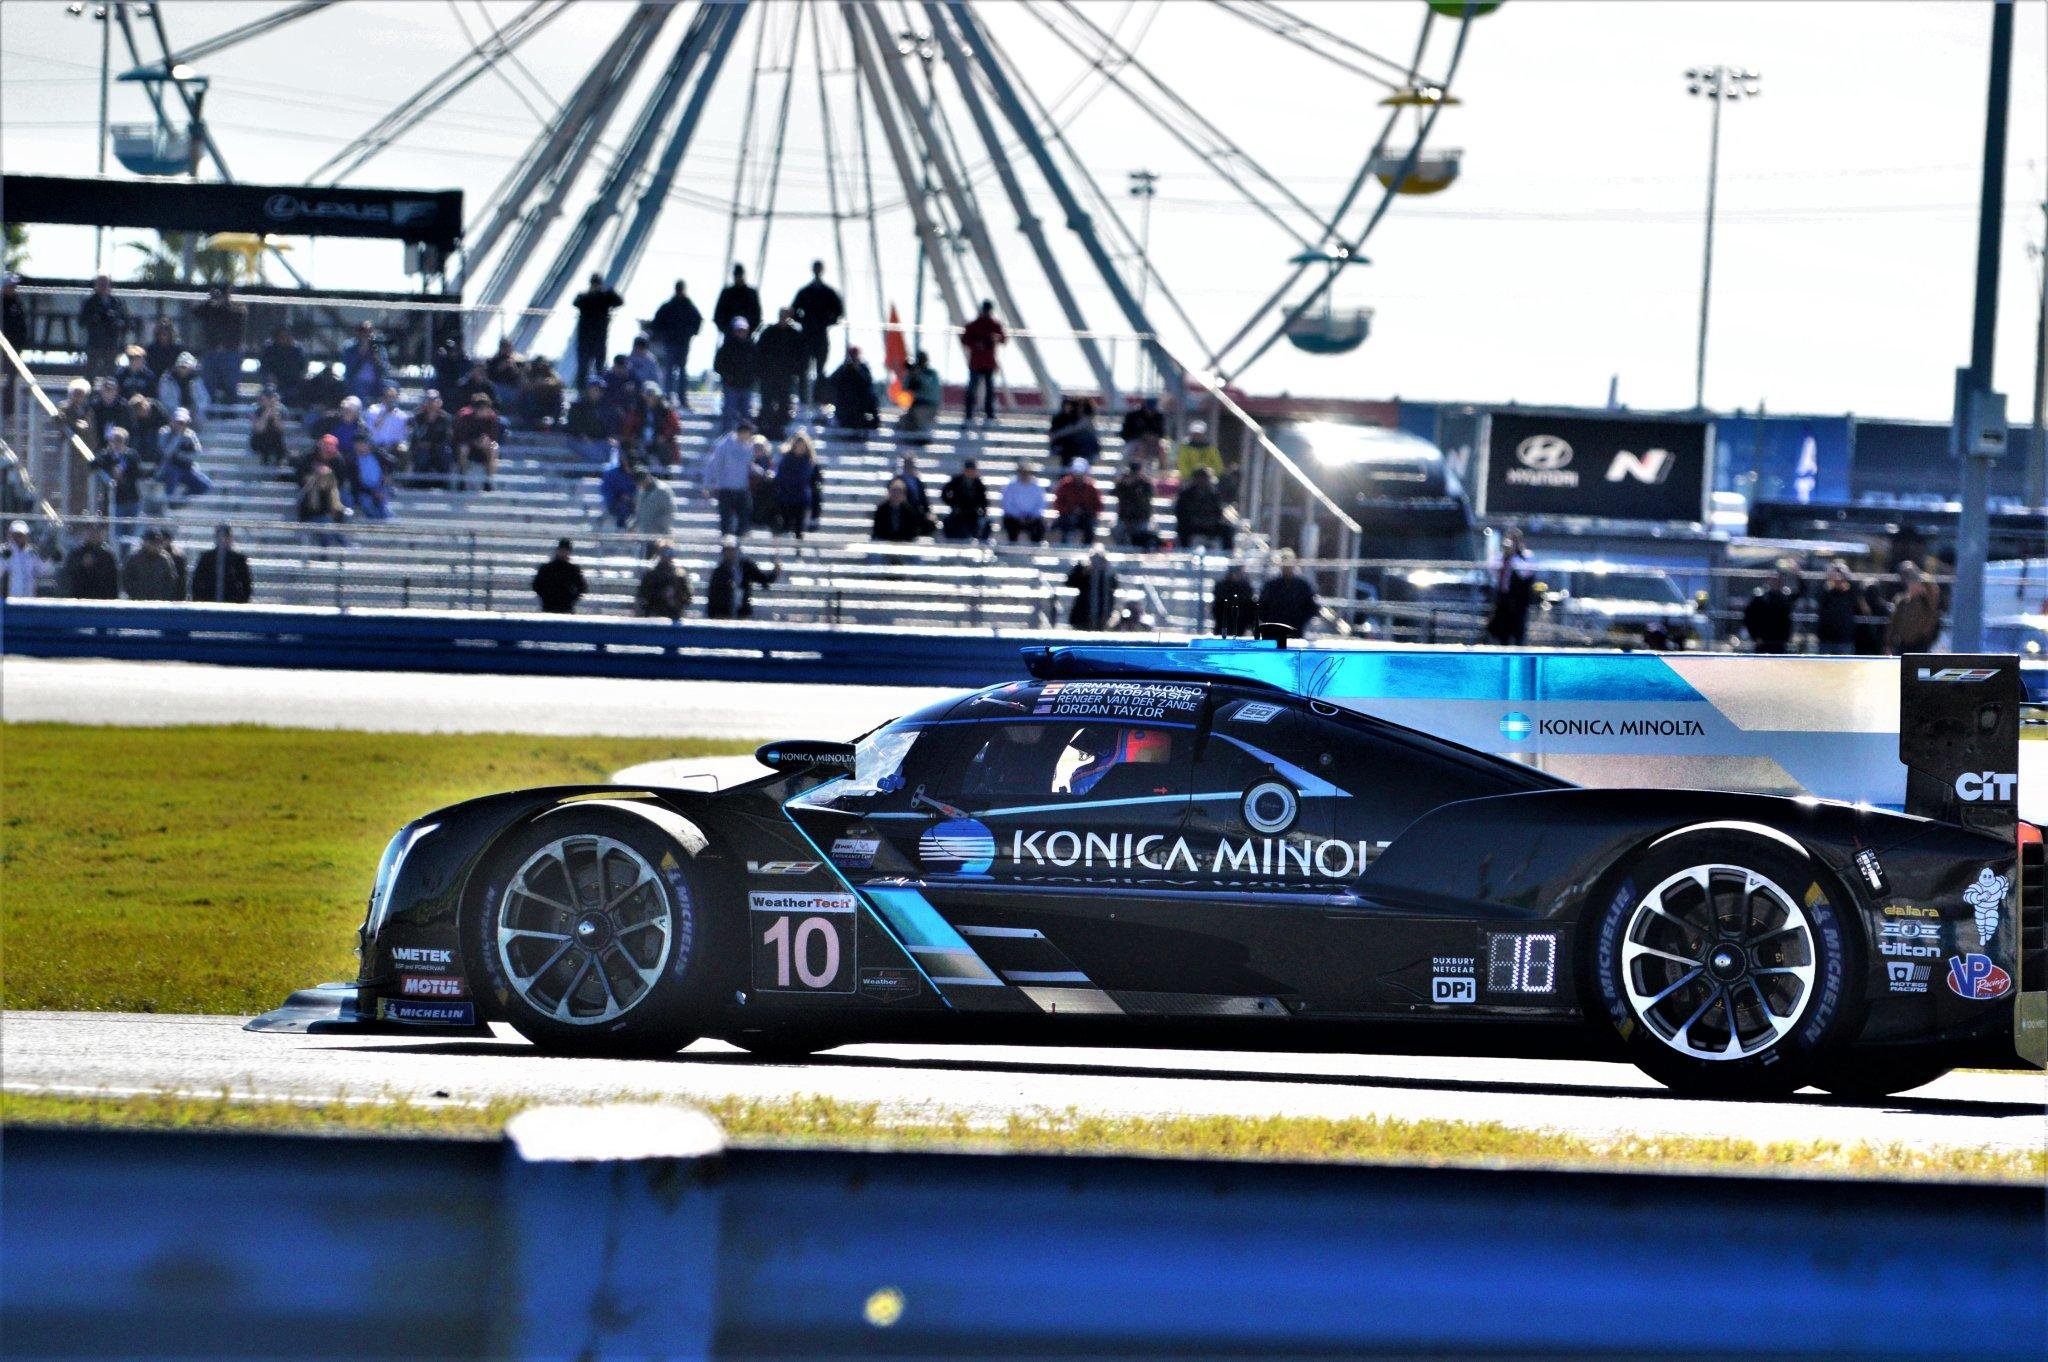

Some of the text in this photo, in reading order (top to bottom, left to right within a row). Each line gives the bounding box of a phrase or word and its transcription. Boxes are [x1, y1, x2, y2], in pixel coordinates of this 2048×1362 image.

[301, 200, 390, 220] LEXUS
[1065, 682, 1202, 696] FERNANDO ALONSO
[1113, 689, 1191, 701] KOBAYASHI
[1057, 695, 1197, 711] RENGER VAN DER ZANDE
[1053, 704, 1164, 718] JORDAN TAYLOR
[1539, 719, 1705, 736] KONICA MINOLTA
[781, 753, 857, 763] KONICA MINOLTA
[1013, 829, 1198, 872] KONICA
[752, 896, 852, 909] WeatherTech
[1884, 905, 1939, 918] dallara
[1599, 886, 1632, 998] MICHELIN
[1878, 942, 1941, 957] tilton
[764, 916, 840, 988] 10
[1433, 957, 1475, 965] DUXBURY
[1511, 934, 1557, 992] 10
[1433, 966, 1475, 974] NETGEAR
[1948, 953, 1992, 999] VP
[404, 979, 461, 995] MOTUL
[1436, 981, 1473, 998] DPi
[1804, 928, 1842, 1043] MICHELIN
[1976, 977, 2008, 992] Racing
[400, 1008, 464, 1018] MICHELIN
